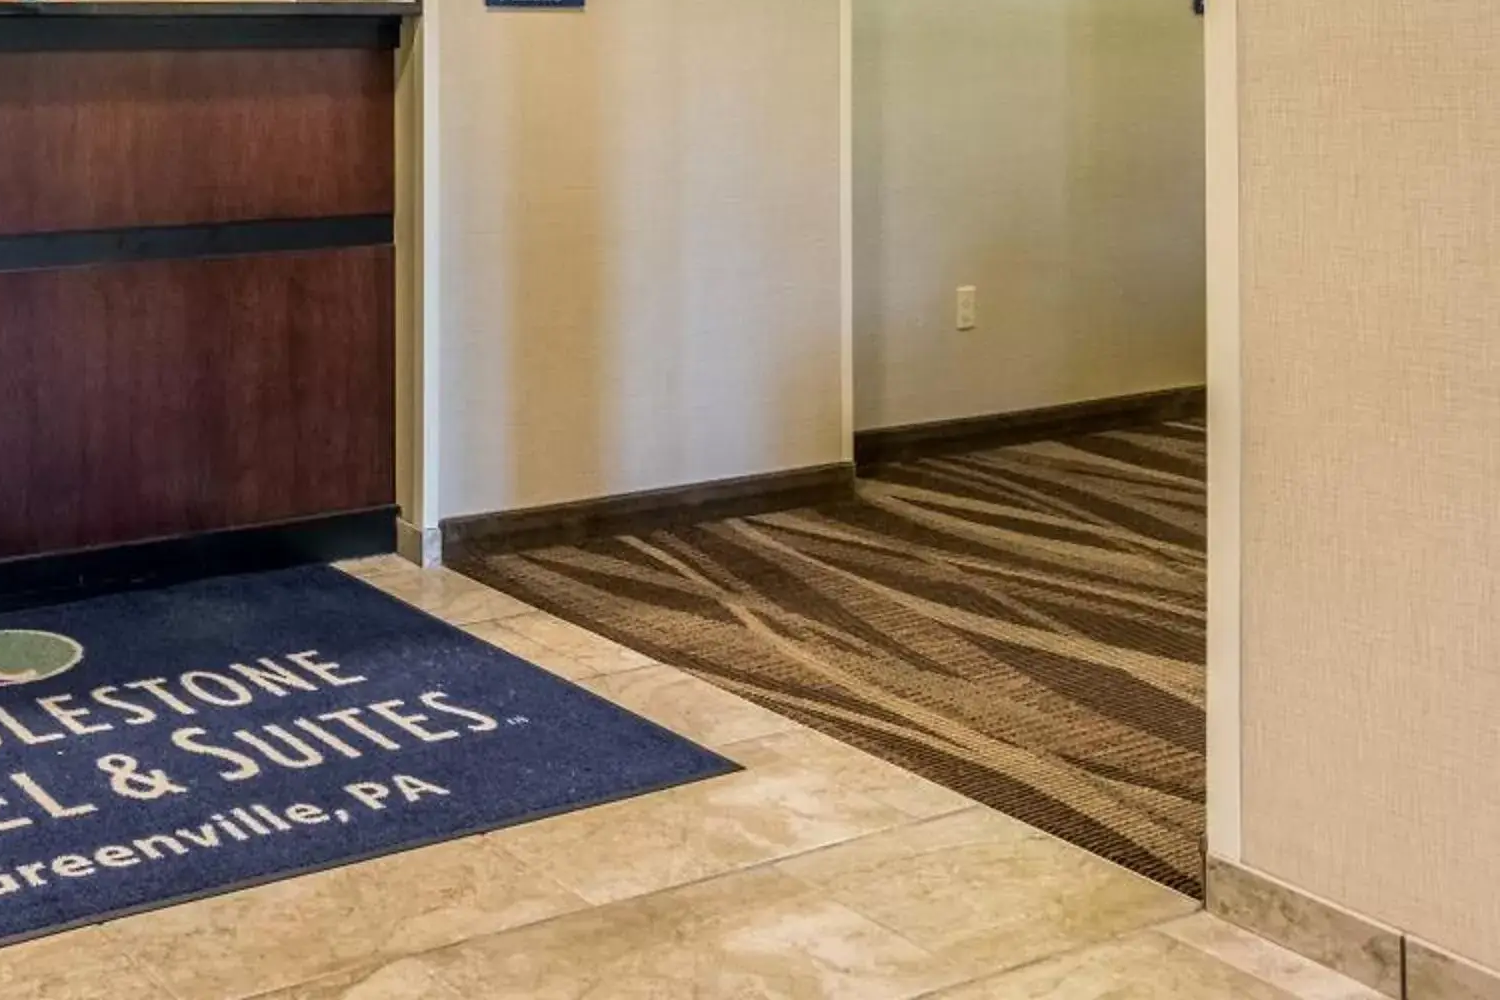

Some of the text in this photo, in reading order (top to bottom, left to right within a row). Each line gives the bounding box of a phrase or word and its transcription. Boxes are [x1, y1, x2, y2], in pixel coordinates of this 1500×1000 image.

[96, 753, 188, 801] &
[171, 690, 498, 781] SUITES
[343, 774, 451, 810] PA
